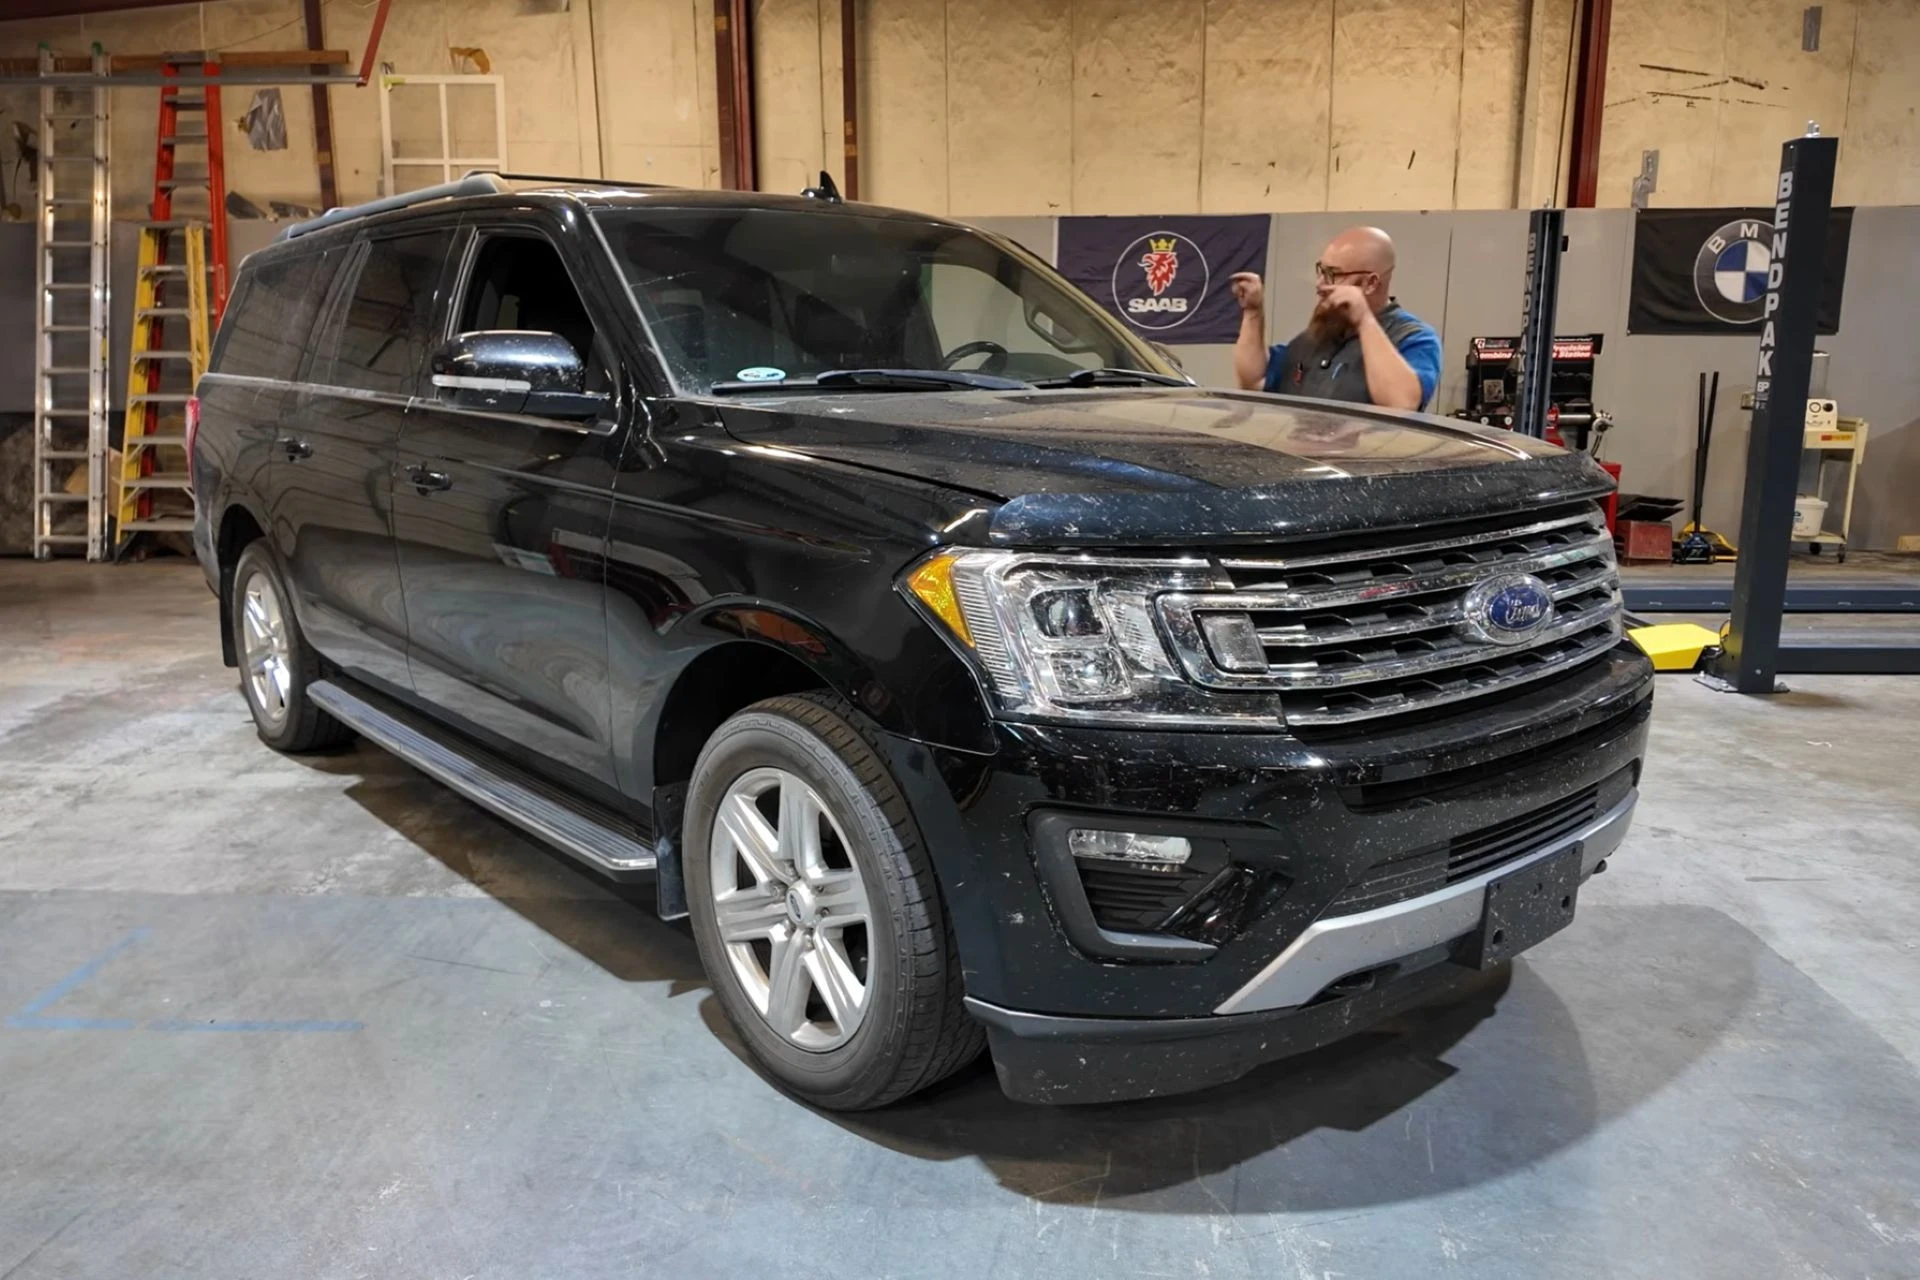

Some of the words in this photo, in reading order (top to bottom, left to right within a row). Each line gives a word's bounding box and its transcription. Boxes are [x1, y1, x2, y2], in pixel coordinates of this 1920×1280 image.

[1707, 223, 1759, 254] BM
[1758, 171, 1793, 377] BENDPAK
[1128, 298, 1187, 312] SAAB
